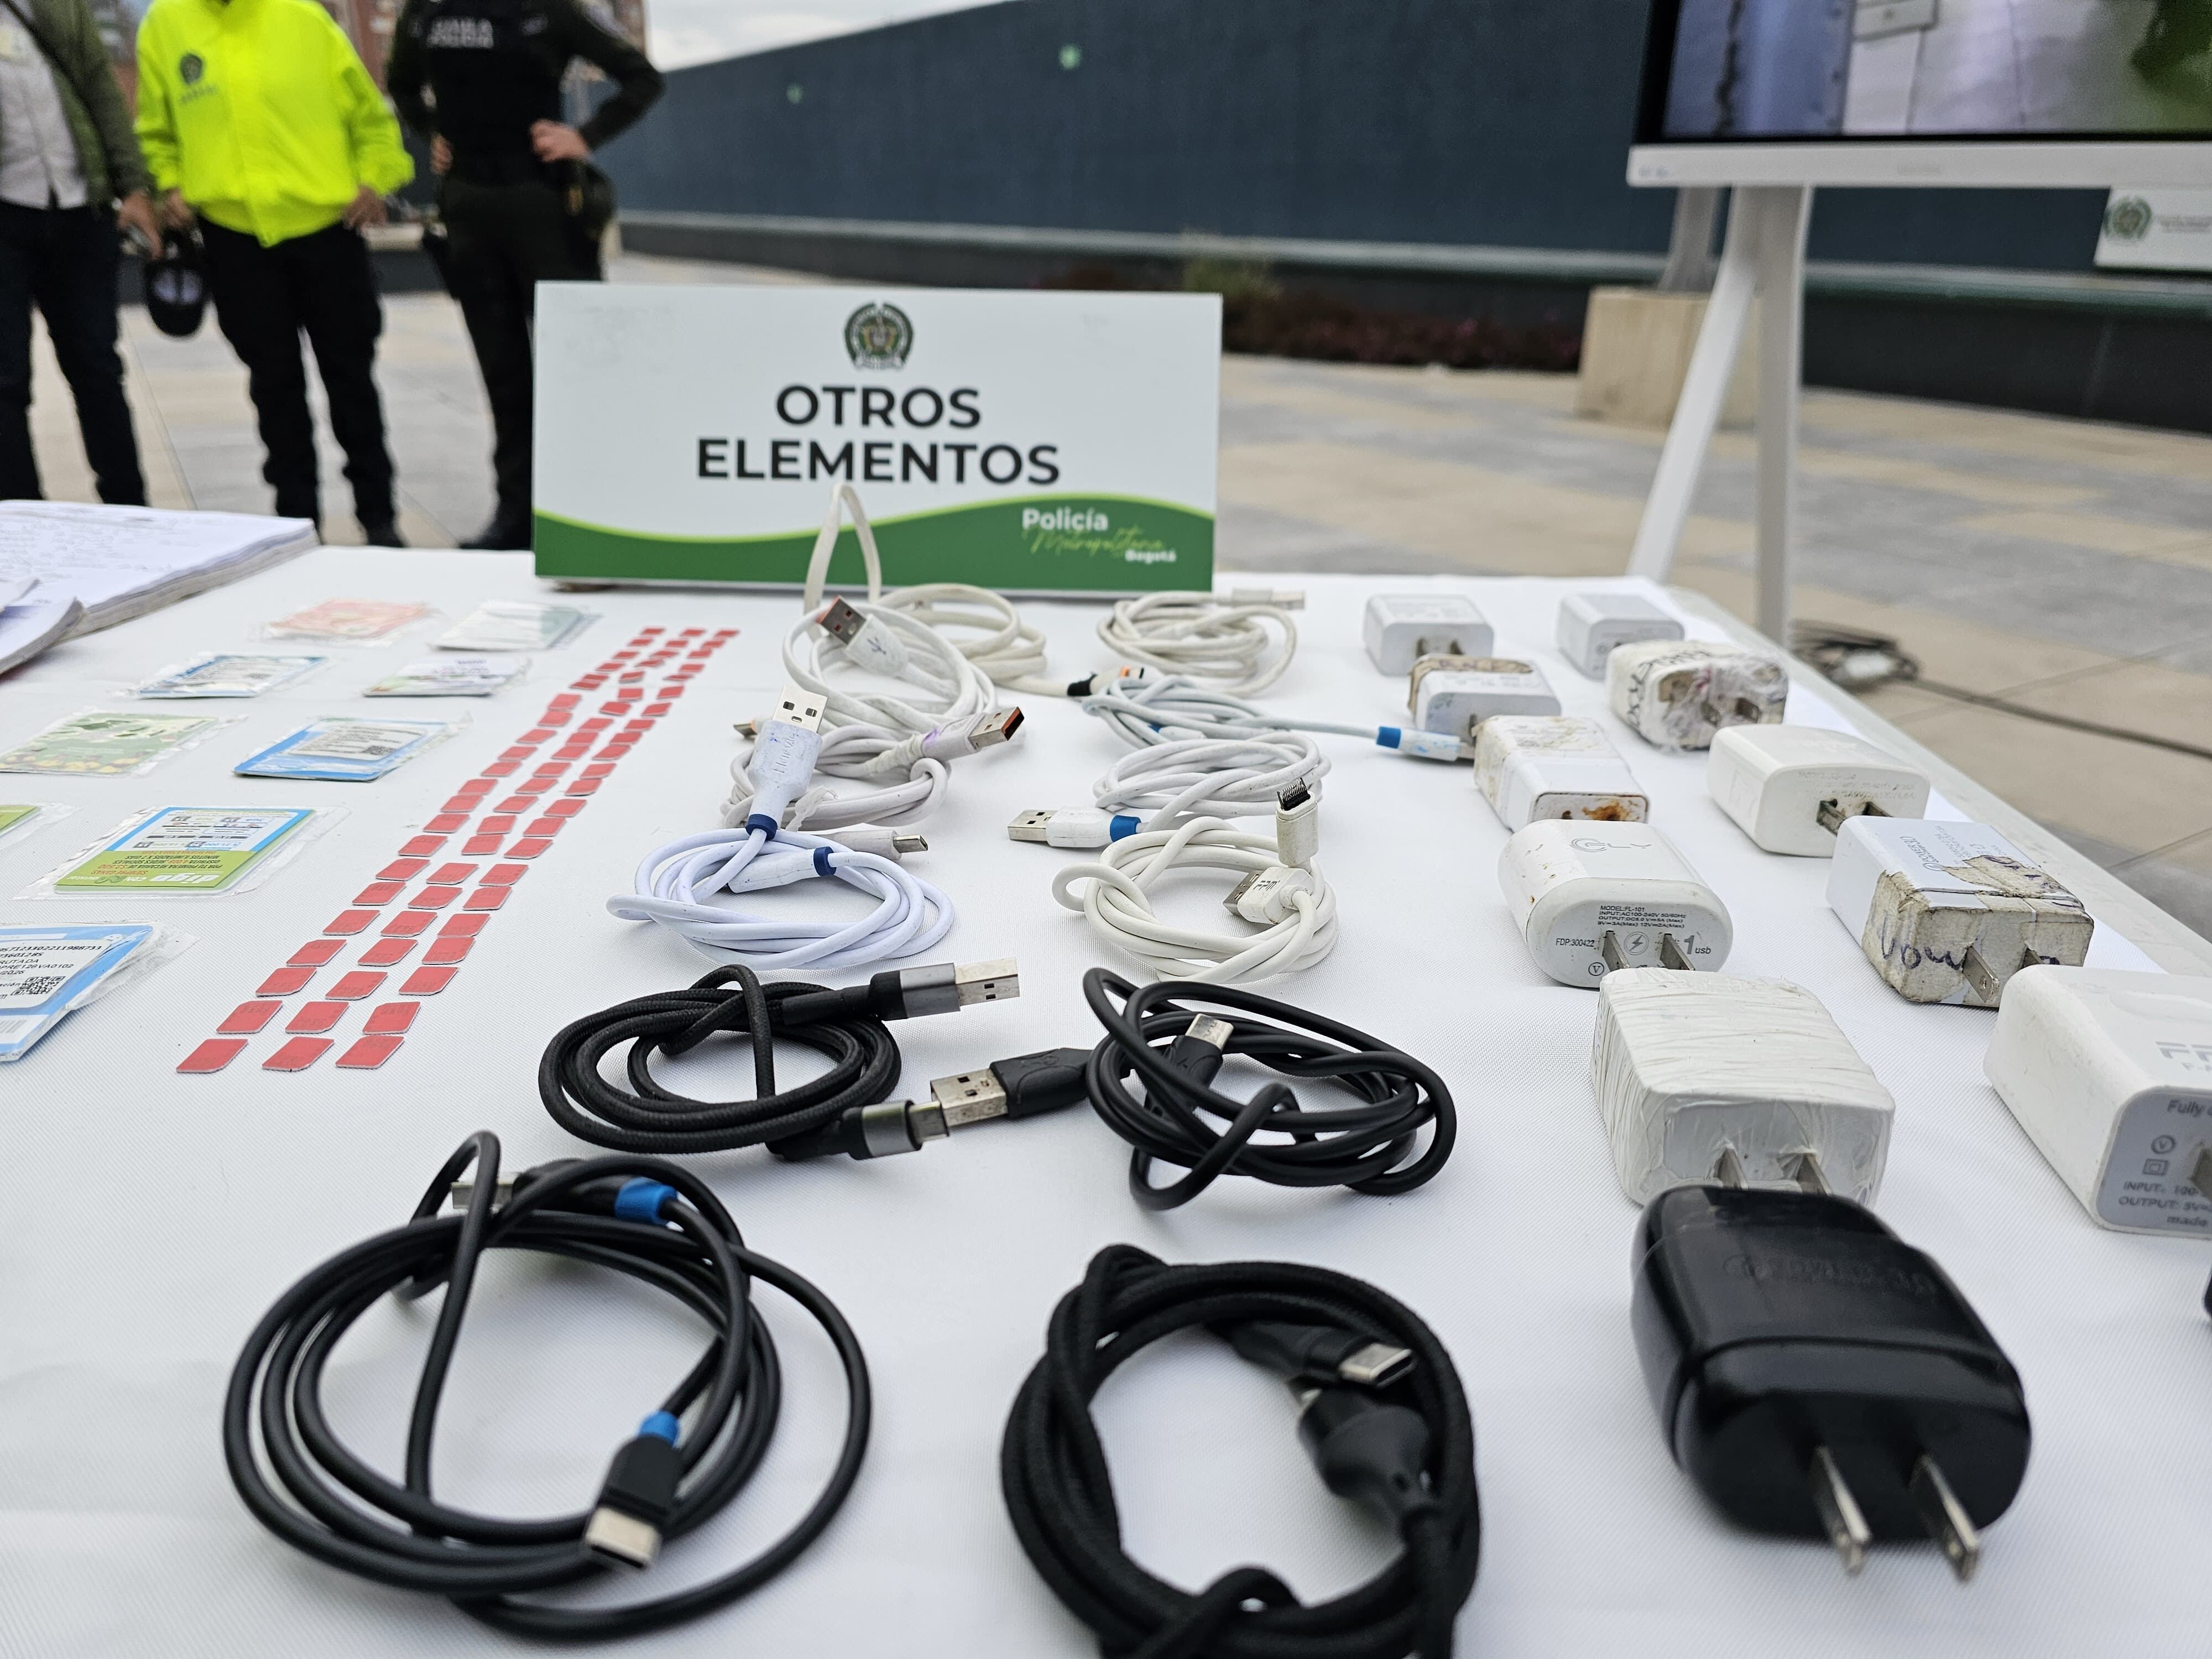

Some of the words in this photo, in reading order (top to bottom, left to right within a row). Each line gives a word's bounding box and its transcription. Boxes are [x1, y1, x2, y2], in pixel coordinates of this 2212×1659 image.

[776, 384, 981, 429] OTROS
[697, 439, 1060, 485] ELEMENTOS
[1022, 505, 1109, 531] Policía
[149, 873, 220, 884] digo
[1556, 938, 1595, 947] FDP:300422
[1695, 946, 1712, 955] usb
[2167, 1099, 2206, 1118] Fully
[2166, 1215, 2209, 1228] made
